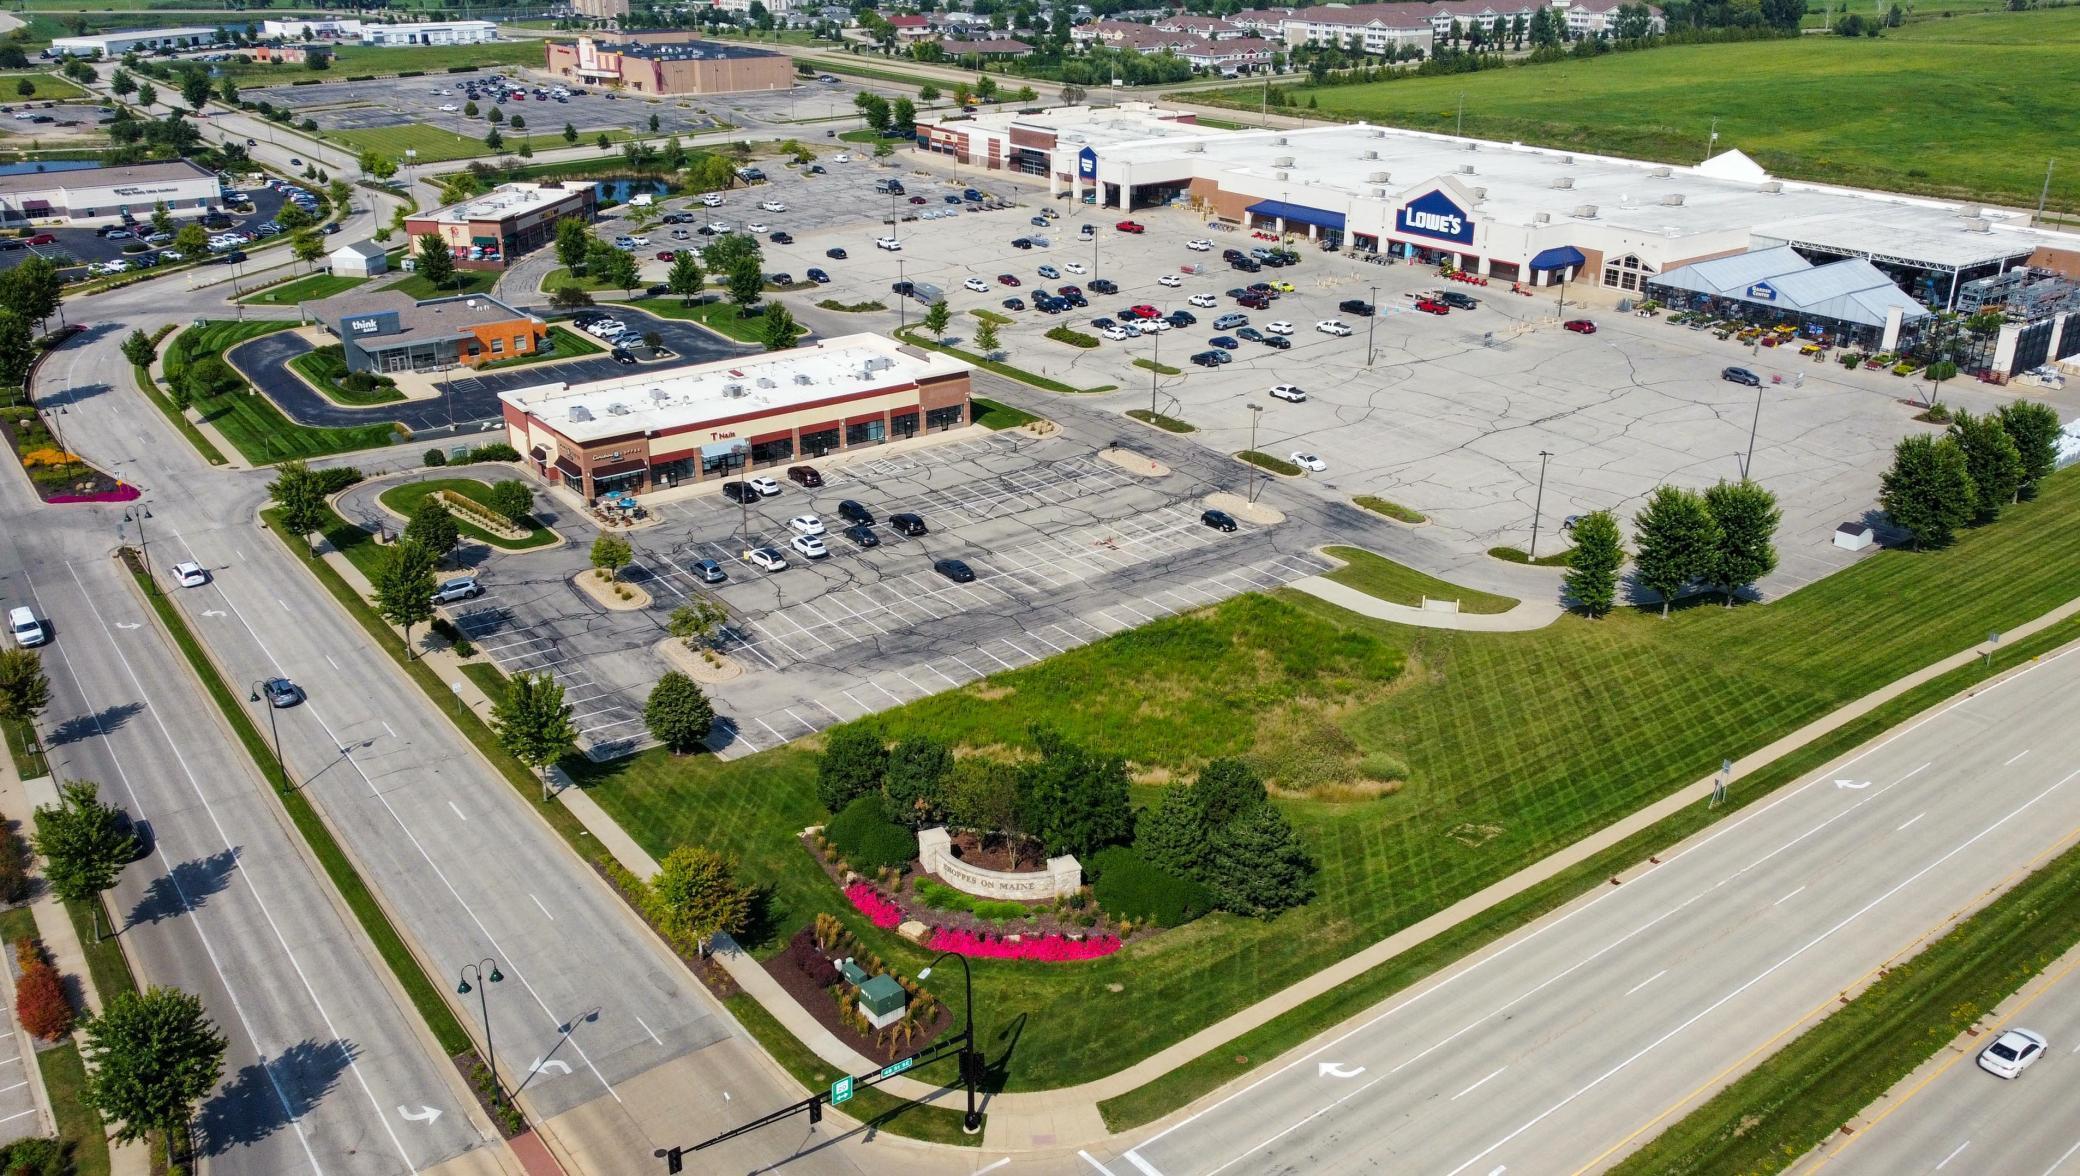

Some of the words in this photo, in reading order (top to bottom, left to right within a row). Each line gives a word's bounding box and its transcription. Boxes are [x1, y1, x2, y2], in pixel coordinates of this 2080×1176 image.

[1406, 207, 1461, 235] LOWE'S
[352, 319, 377, 330] think
[981, 880, 995, 889] ON
[1000, 882, 1035, 891] MAINE
